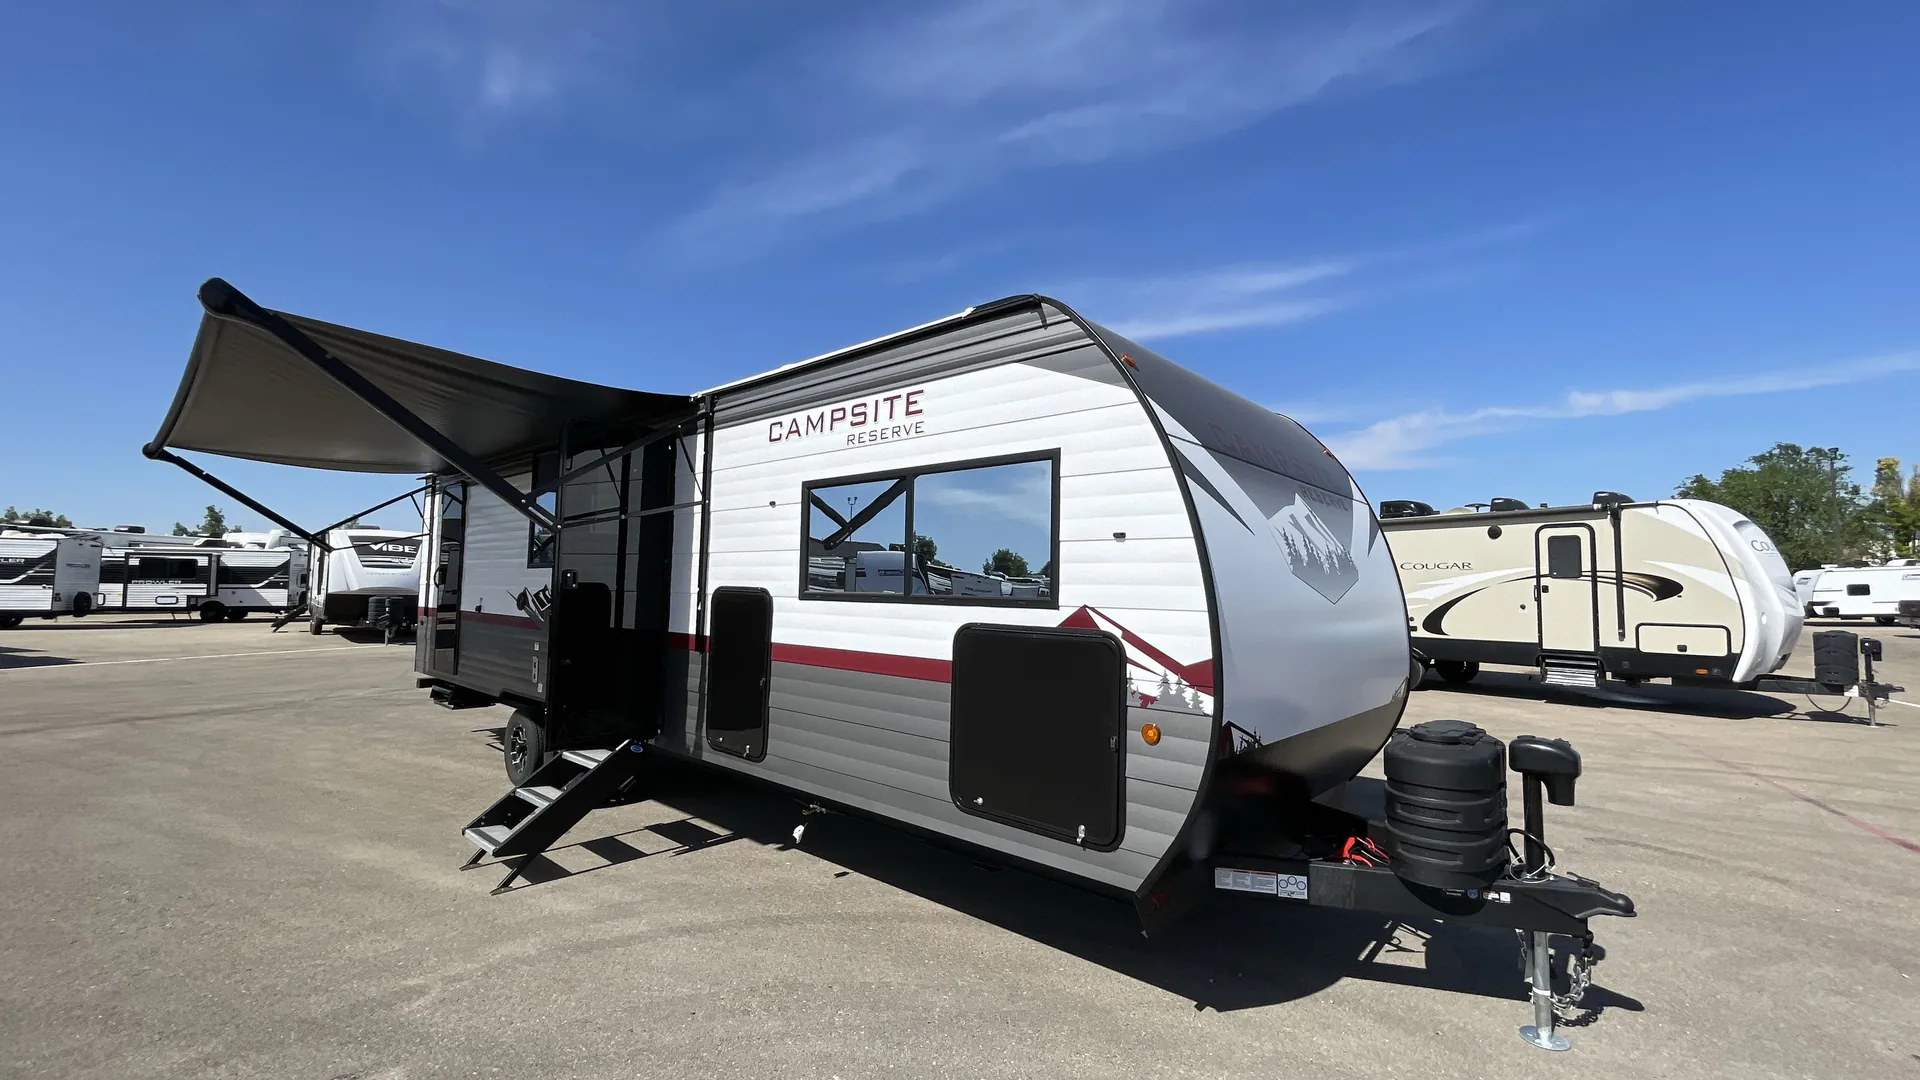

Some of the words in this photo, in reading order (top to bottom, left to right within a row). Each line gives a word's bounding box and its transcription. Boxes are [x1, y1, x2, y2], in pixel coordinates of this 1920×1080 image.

[768, 389, 925, 443] CAMPSITE
[846, 420, 926, 446] RESERVE
[369, 542, 417, 554] VIBE
[1400, 562, 1473, 571] COUGAR
